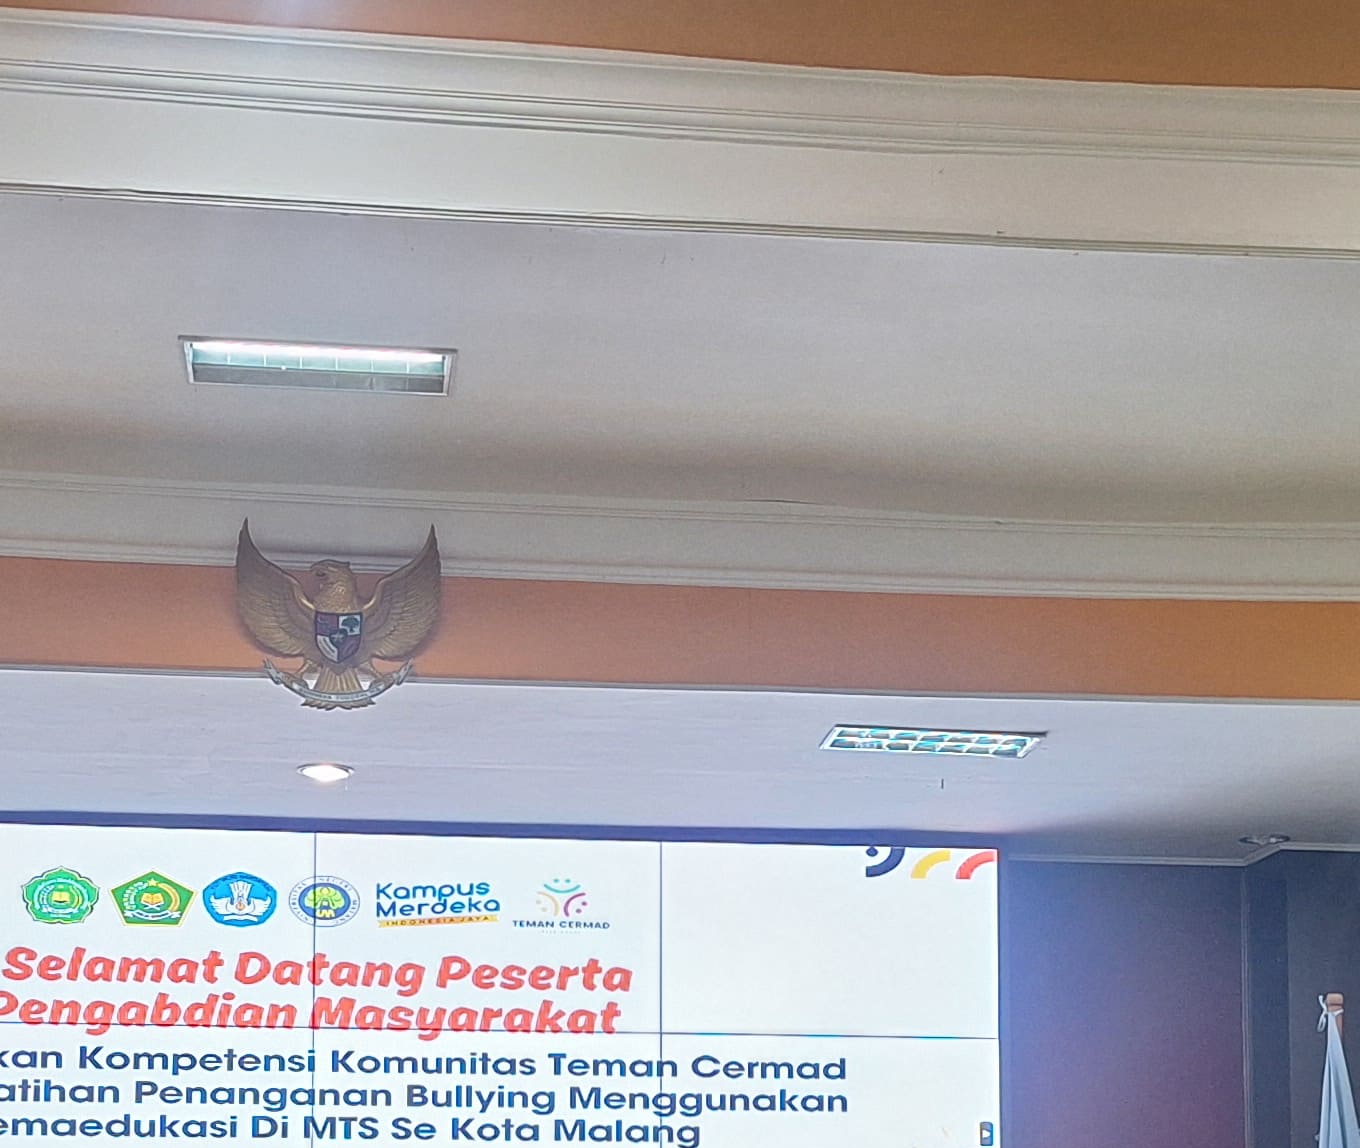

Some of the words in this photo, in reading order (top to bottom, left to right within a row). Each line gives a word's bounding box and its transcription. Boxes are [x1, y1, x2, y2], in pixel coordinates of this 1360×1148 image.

[375, 882, 490, 901] Kampus
[375, 897, 501, 917] Merdeka
[385, 917, 455, 926] INDONESIA
[459, 915, 490, 925] JAYA
[511, 920, 555, 929] TEMAN
[558, 920, 611, 930] CERMAD
[1, 946, 225, 984] Selamat
[234, 951, 426, 997] Datang
[436, 955, 633, 992] Peserta
[309, 996, 622, 1041] Masyarakat
[78, 1045, 316, 1075] Kompetensi
[331, 1050, 537, 1076] Komunitas
[548, 1053, 678, 1078] Teman
[691, 1055, 847, 1080] Cermad
[134, 1080, 392, 1112] Penanganan
[406, 1084, 556, 1114] Bullying
[569, 1086, 848, 1117] Menggunakan
[251, 1115, 289, 1139] Di
[303, 1116, 379, 1140] MTS
[390, 1117, 437, 1141] Se
[451, 1117, 540, 1142] Kota
[553, 1119, 701, 1148] Malang
